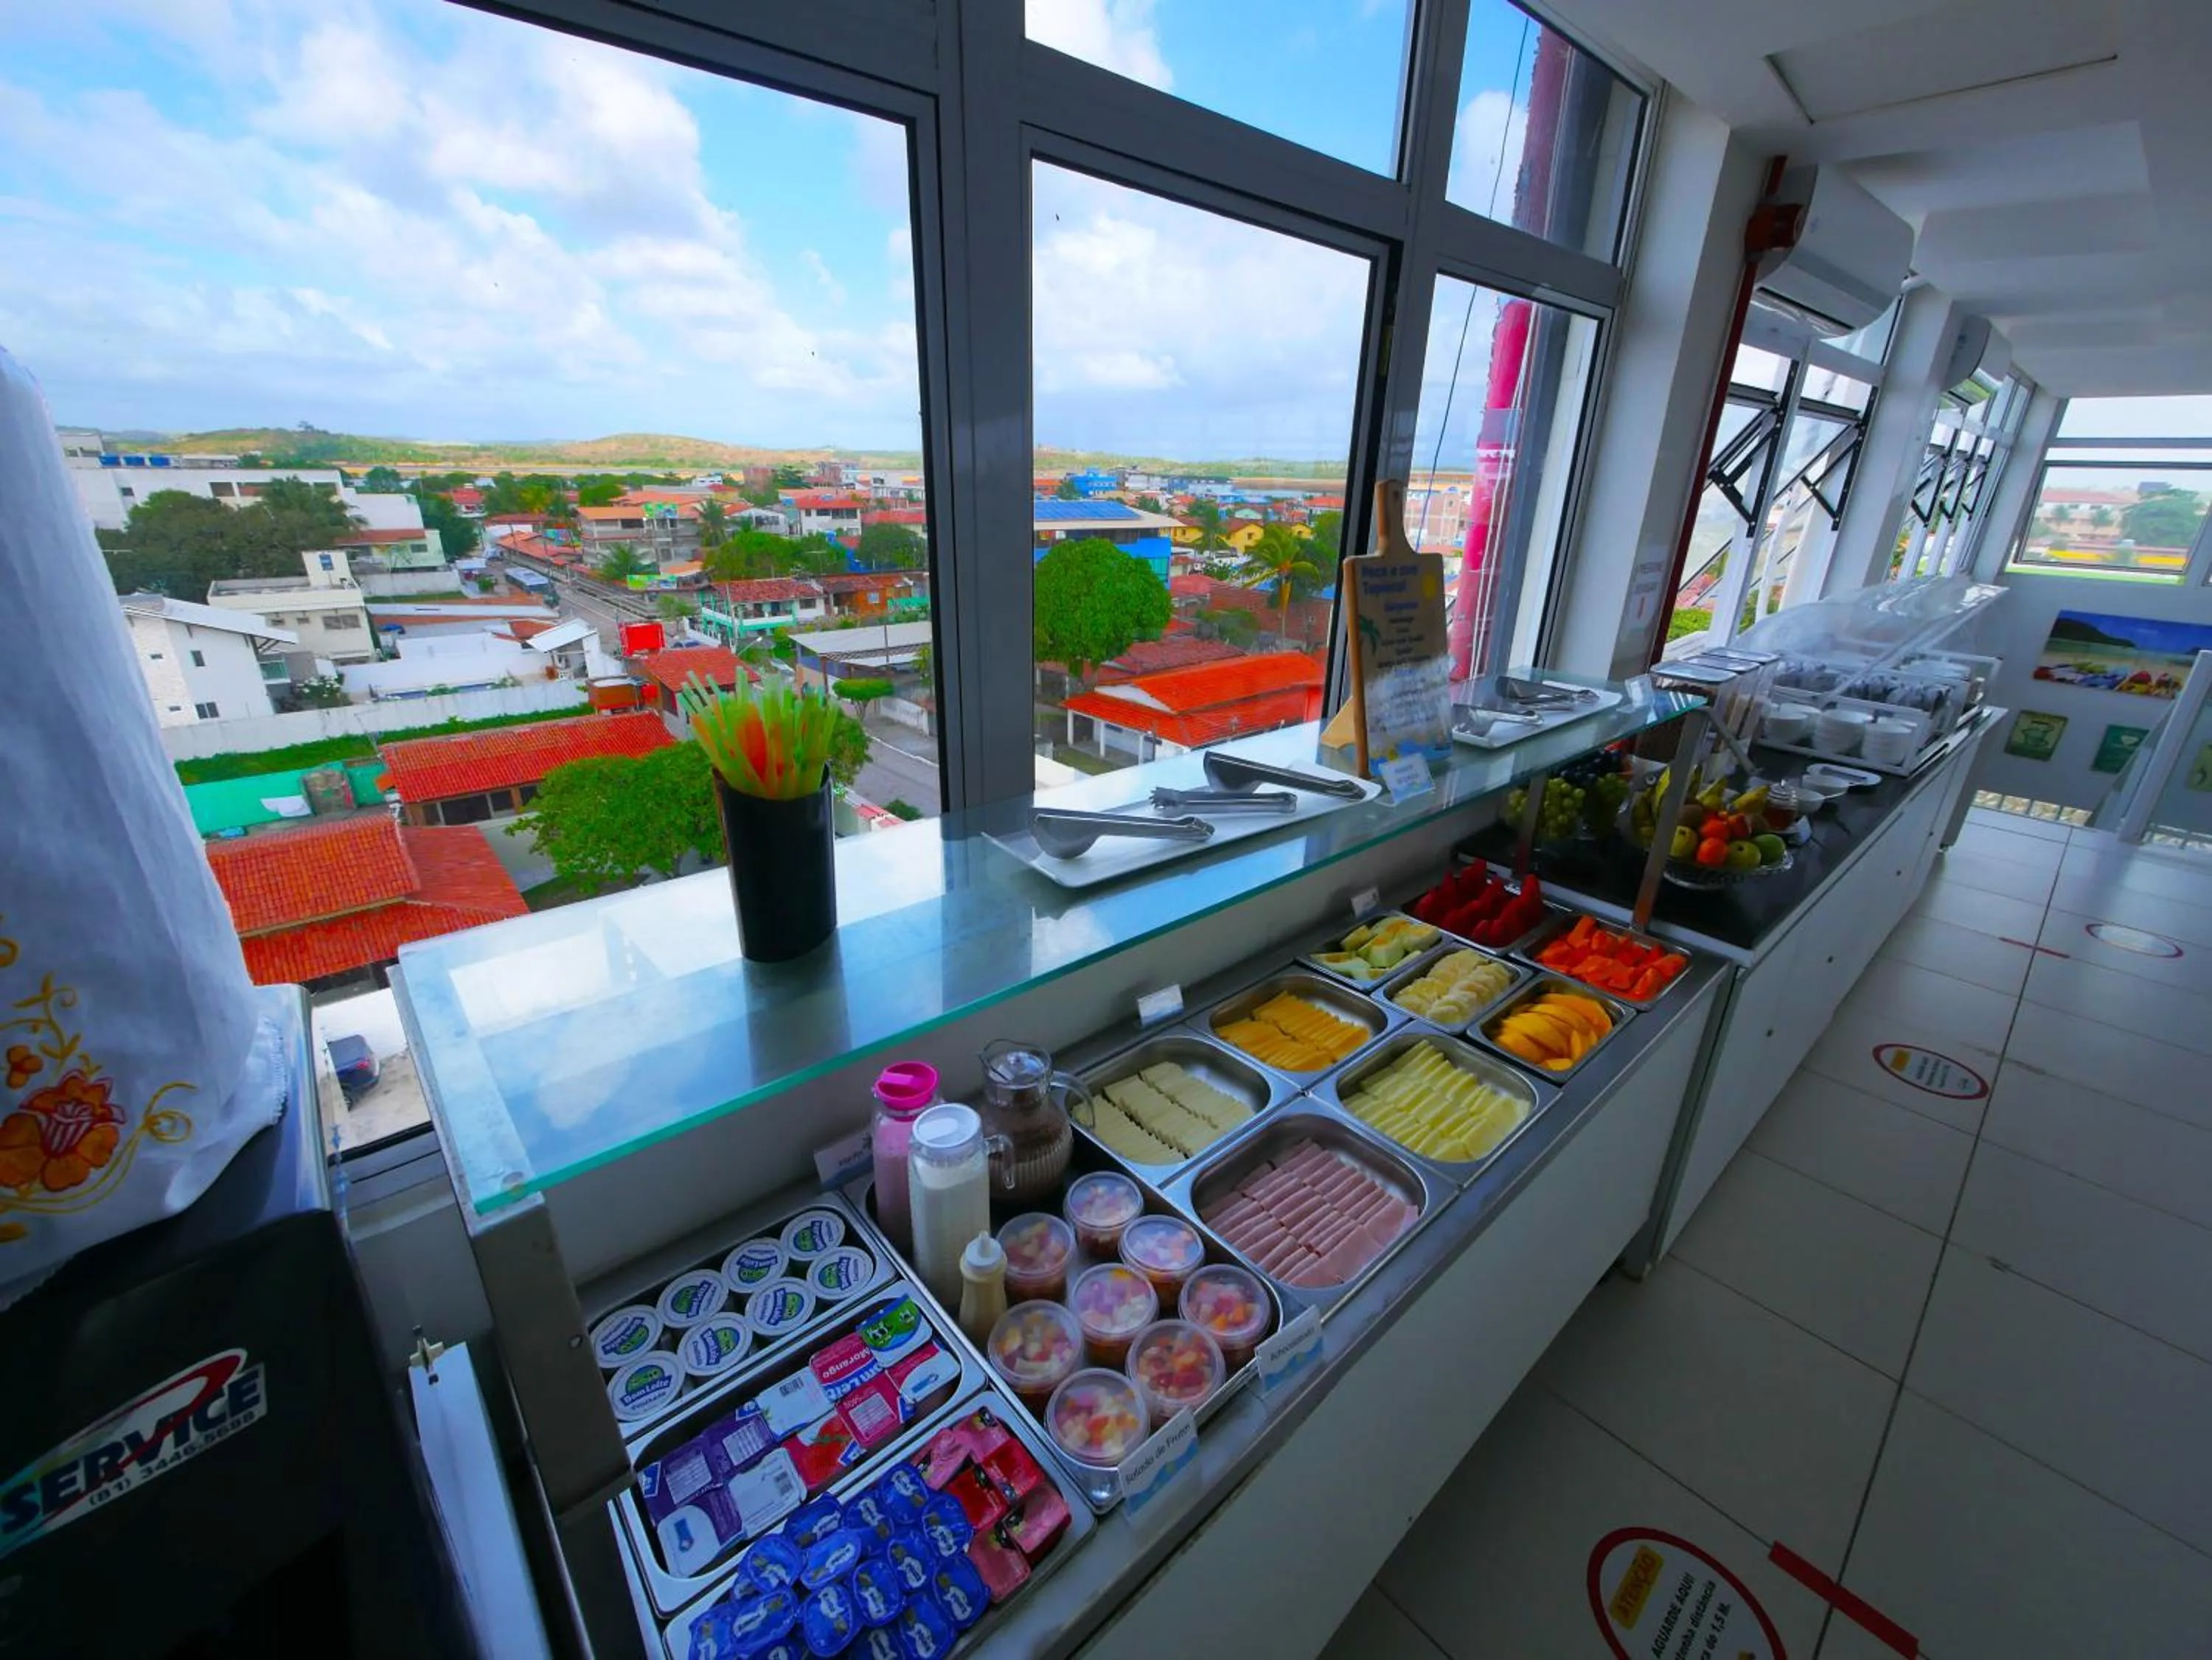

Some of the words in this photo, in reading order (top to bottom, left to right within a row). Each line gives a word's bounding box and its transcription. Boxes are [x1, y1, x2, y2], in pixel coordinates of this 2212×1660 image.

[822, 1347, 870, 1378] Morango
[1, 1370, 261, 1533] SERVICE
[88, 1477, 131, 1505] (81)
[1652, 1601, 1681, 1659] AGUARDE
